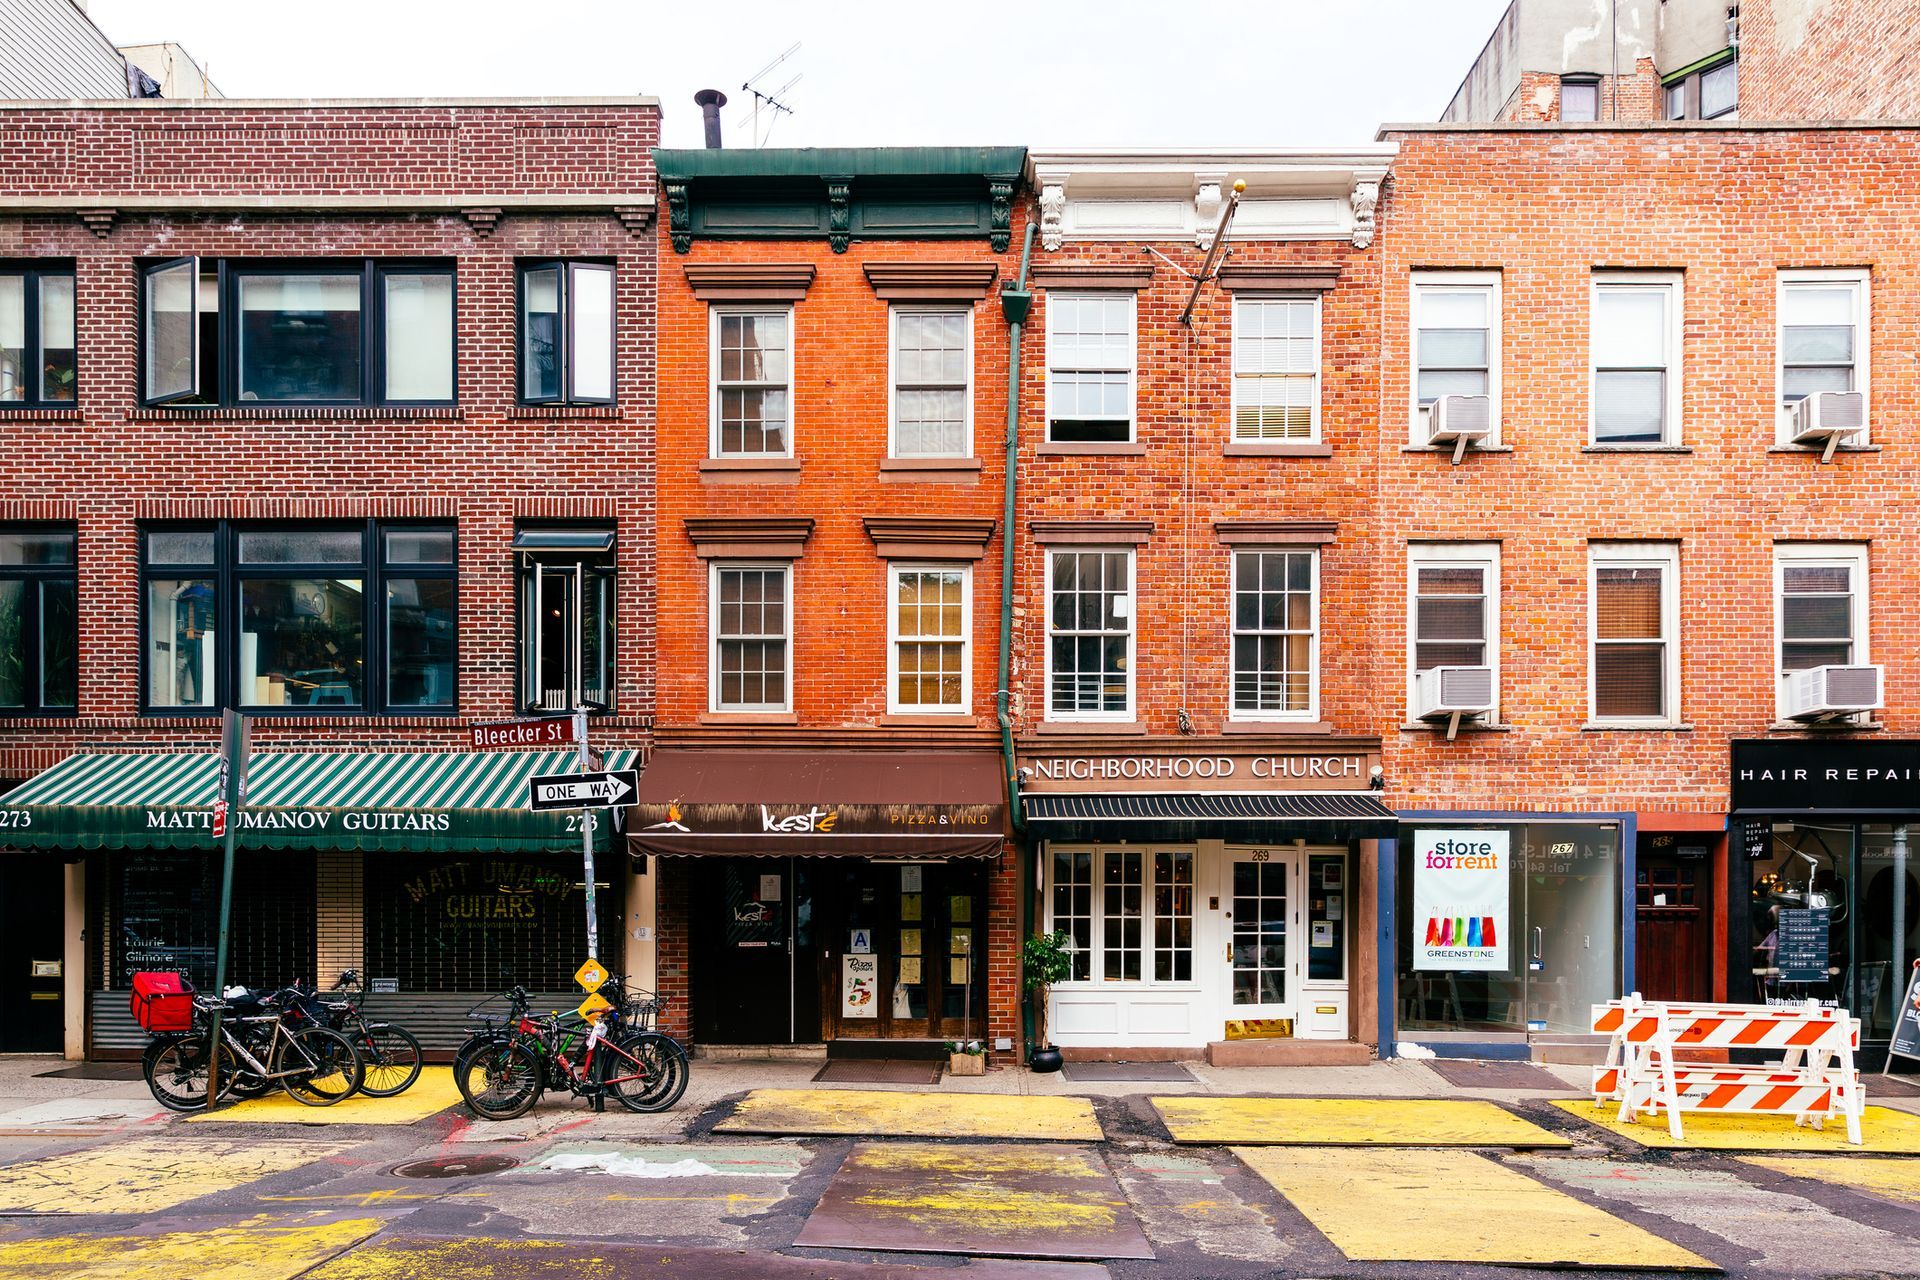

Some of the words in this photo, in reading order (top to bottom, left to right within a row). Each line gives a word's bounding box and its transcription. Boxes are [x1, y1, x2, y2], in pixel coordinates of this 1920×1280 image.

[474, 725, 541, 746] Bleecker
[547, 723, 562, 740] St
[1035, 758, 1235, 779] NEIGHBORHOOD
[1250, 756, 1361, 778] CHURCH
[1740, 769, 1808, 781] HAIR
[546, 784, 577, 800] ONE
[590, 782, 621, 797] WAY
[0, 810, 32, 828] 273
[146, 810, 214, 829] MATT
[342, 810, 451, 831] GUITARS
[1435, 839, 1492, 856] store
[1552, 843, 1573, 853] 267
[1251, 850, 1270, 862] 269
[854, 932, 867, 947] A
[125, 951, 174, 962] Gilmore
[1427, 950, 1495, 958] GREENSTONE
